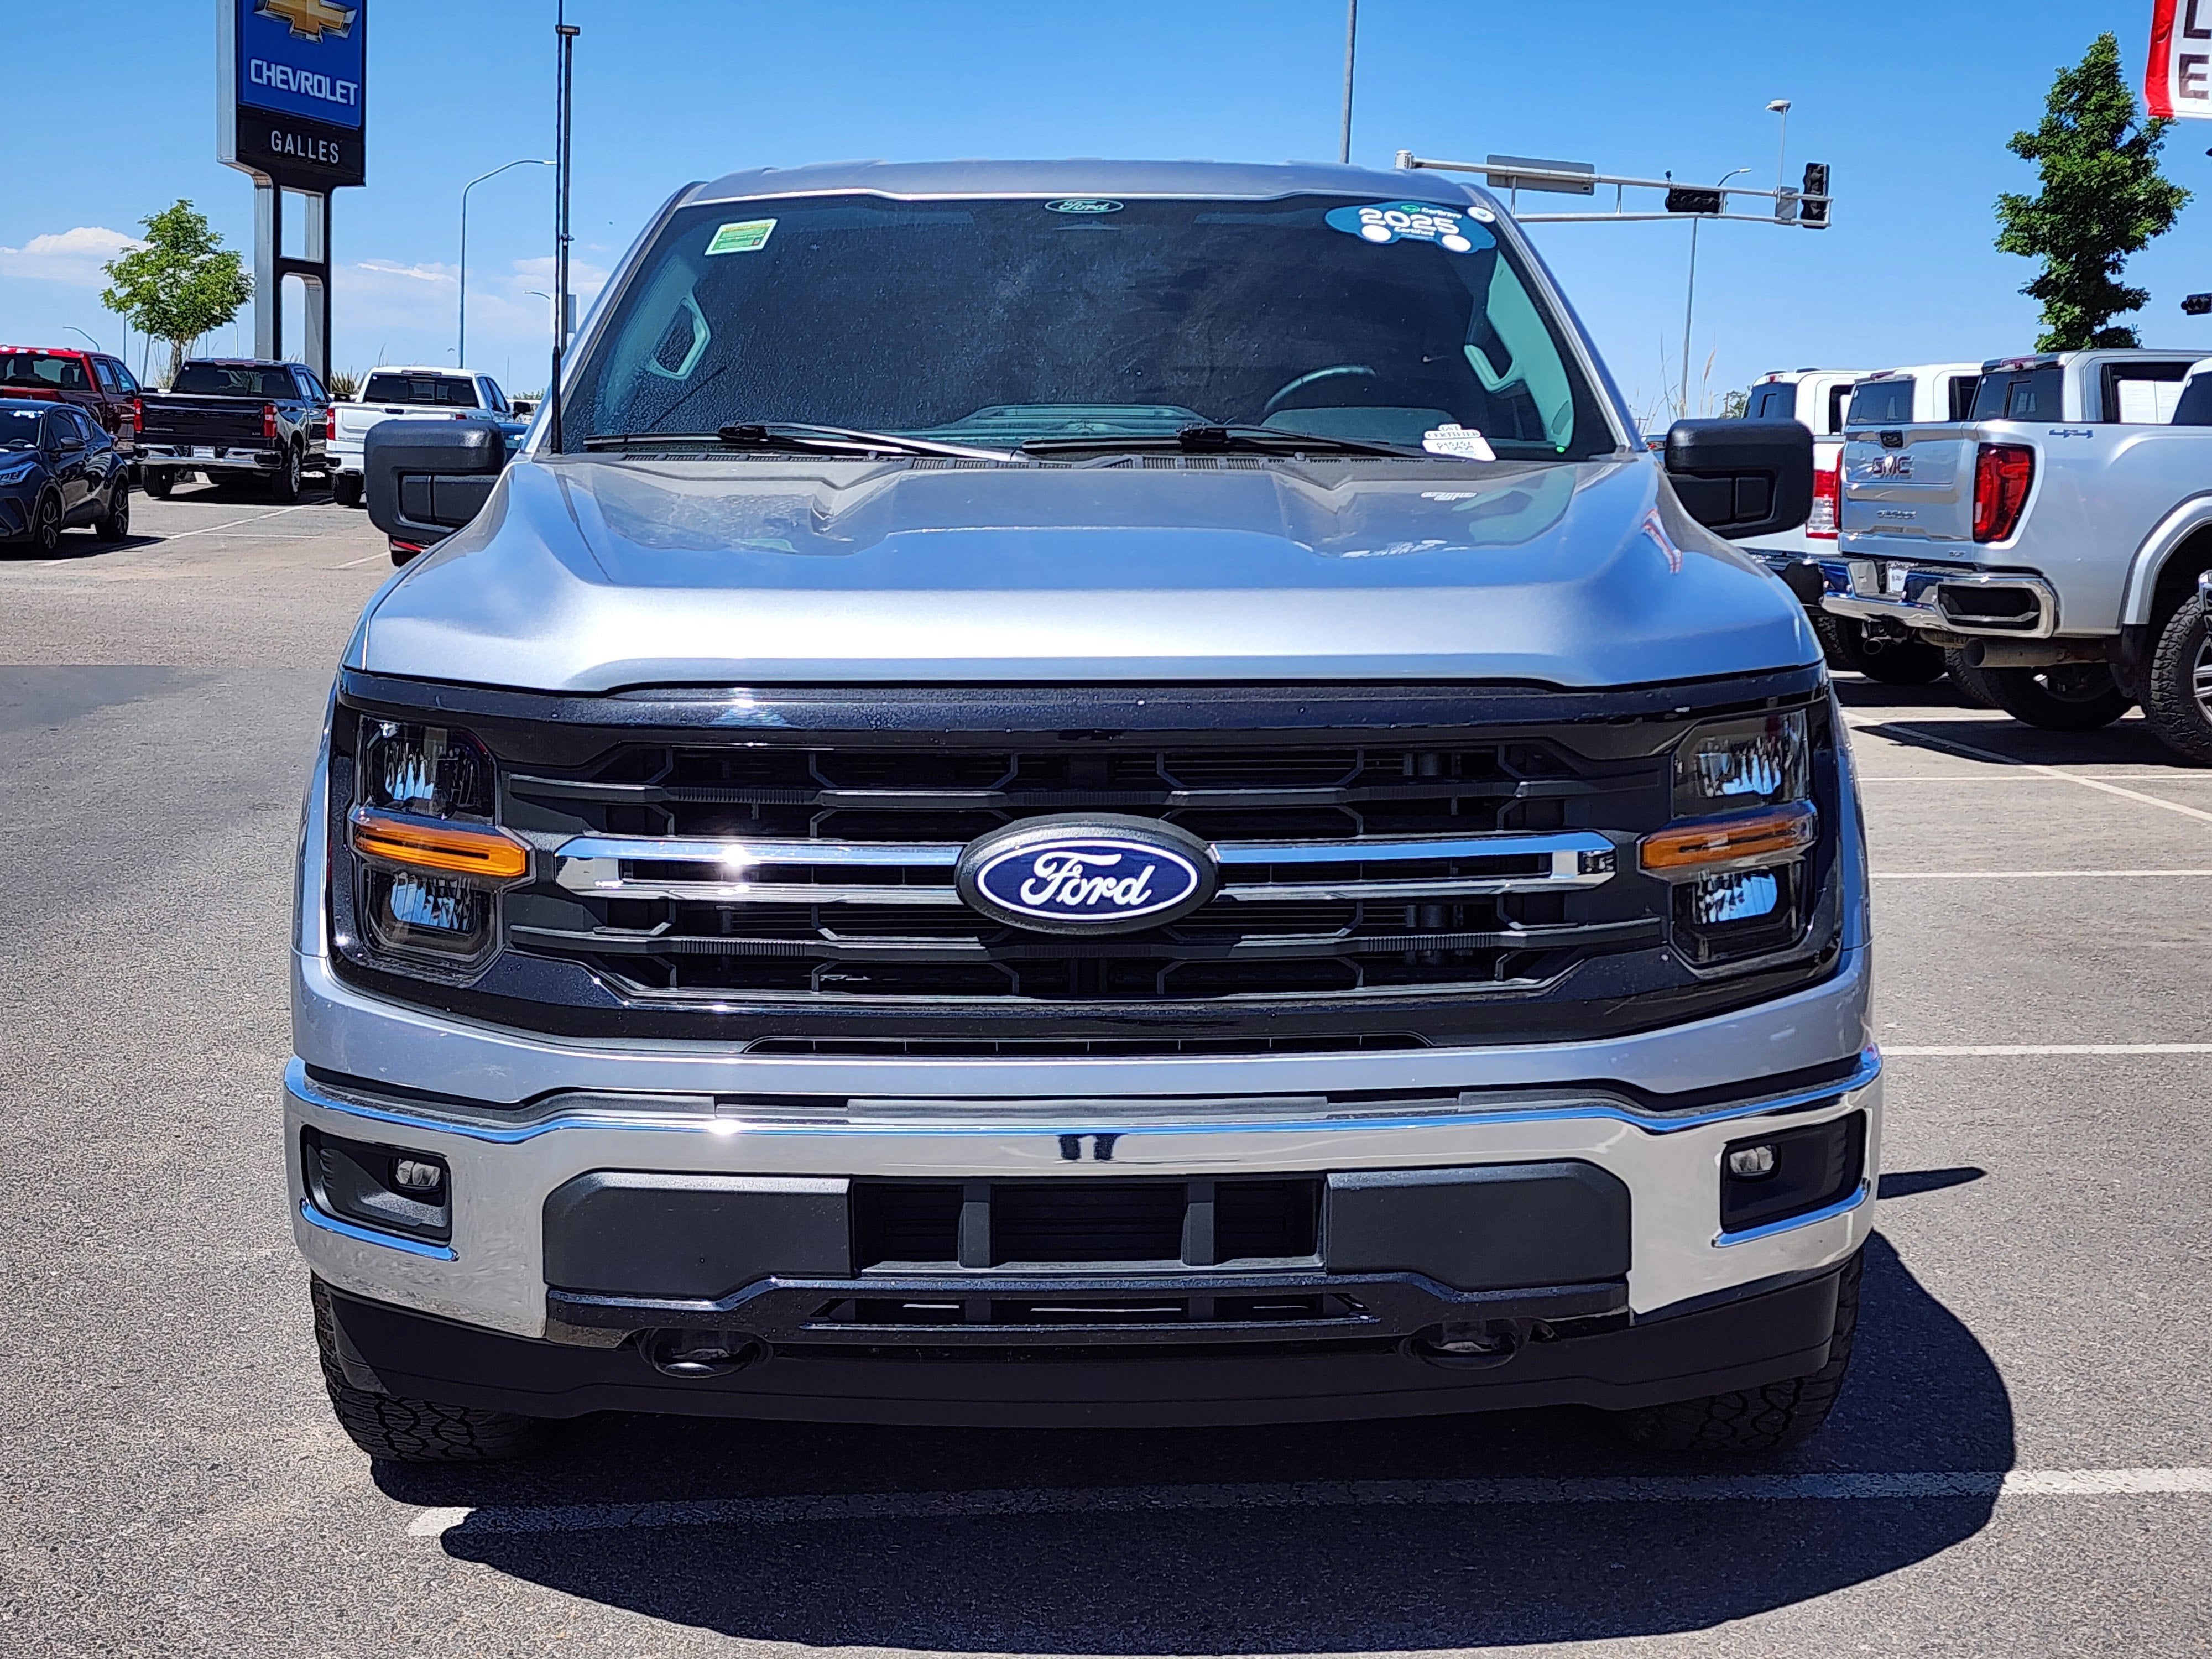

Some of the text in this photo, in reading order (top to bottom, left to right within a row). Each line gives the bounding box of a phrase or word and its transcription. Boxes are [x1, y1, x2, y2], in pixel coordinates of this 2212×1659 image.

[251, 59, 358, 105] CHEVROLET
[2179, 53, 2210, 100] E
[271, 130, 339, 164] GALLES
[1058, 199, 1109, 210] Ford
[1358, 208, 1460, 234] 2025
[1020, 851, 1156, 906] Ford
